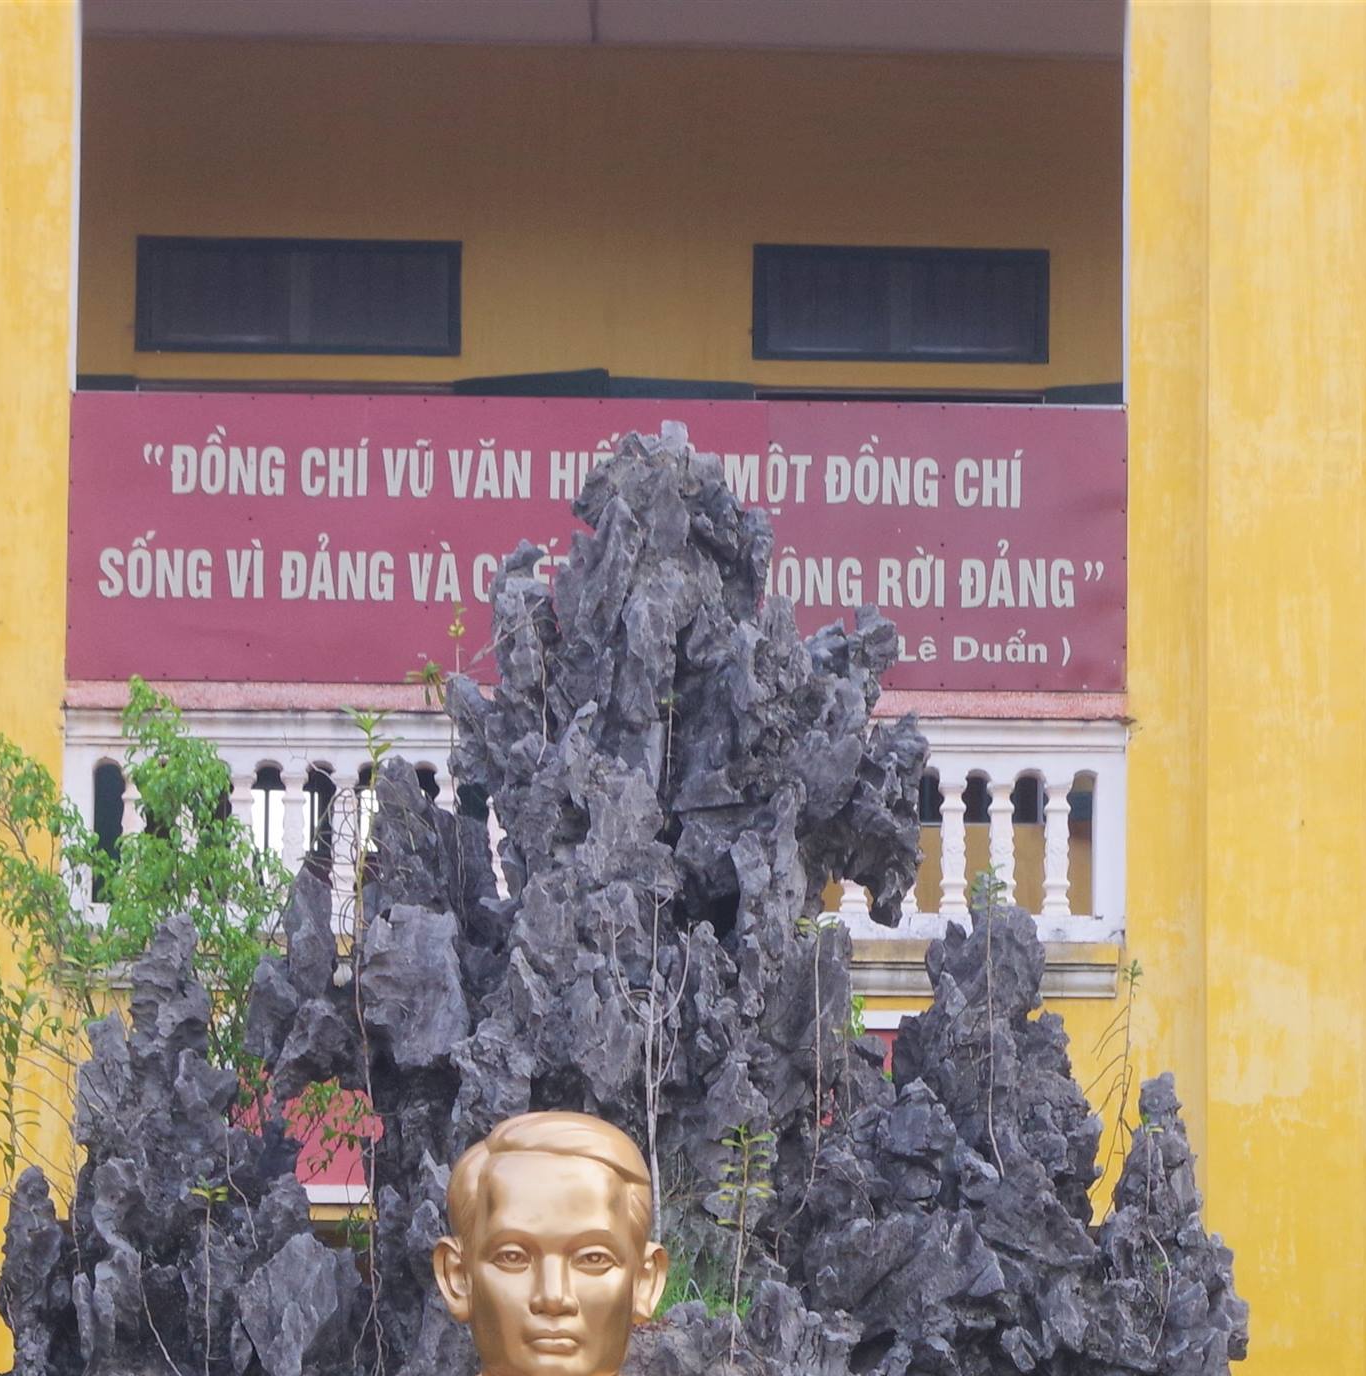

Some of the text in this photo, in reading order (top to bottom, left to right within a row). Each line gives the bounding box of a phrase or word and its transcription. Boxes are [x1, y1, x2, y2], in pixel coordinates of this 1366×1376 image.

[300, 437, 369, 498] CHÍ
[382, 438, 434, 499] VŨ
[447, 438, 532, 500] VĂN
[723, 435, 1025, 516] MỘT ĐỒNG CHÍ
[98, 530, 213, 600] SỐNG
[226, 538, 265, 600] VÌ
[280, 533, 395, 602] ĐẢNG
[408, 541, 460, 603] VÀ
[878, 546, 945, 609] RỜI
[897, 634, 938, 663] Lê
